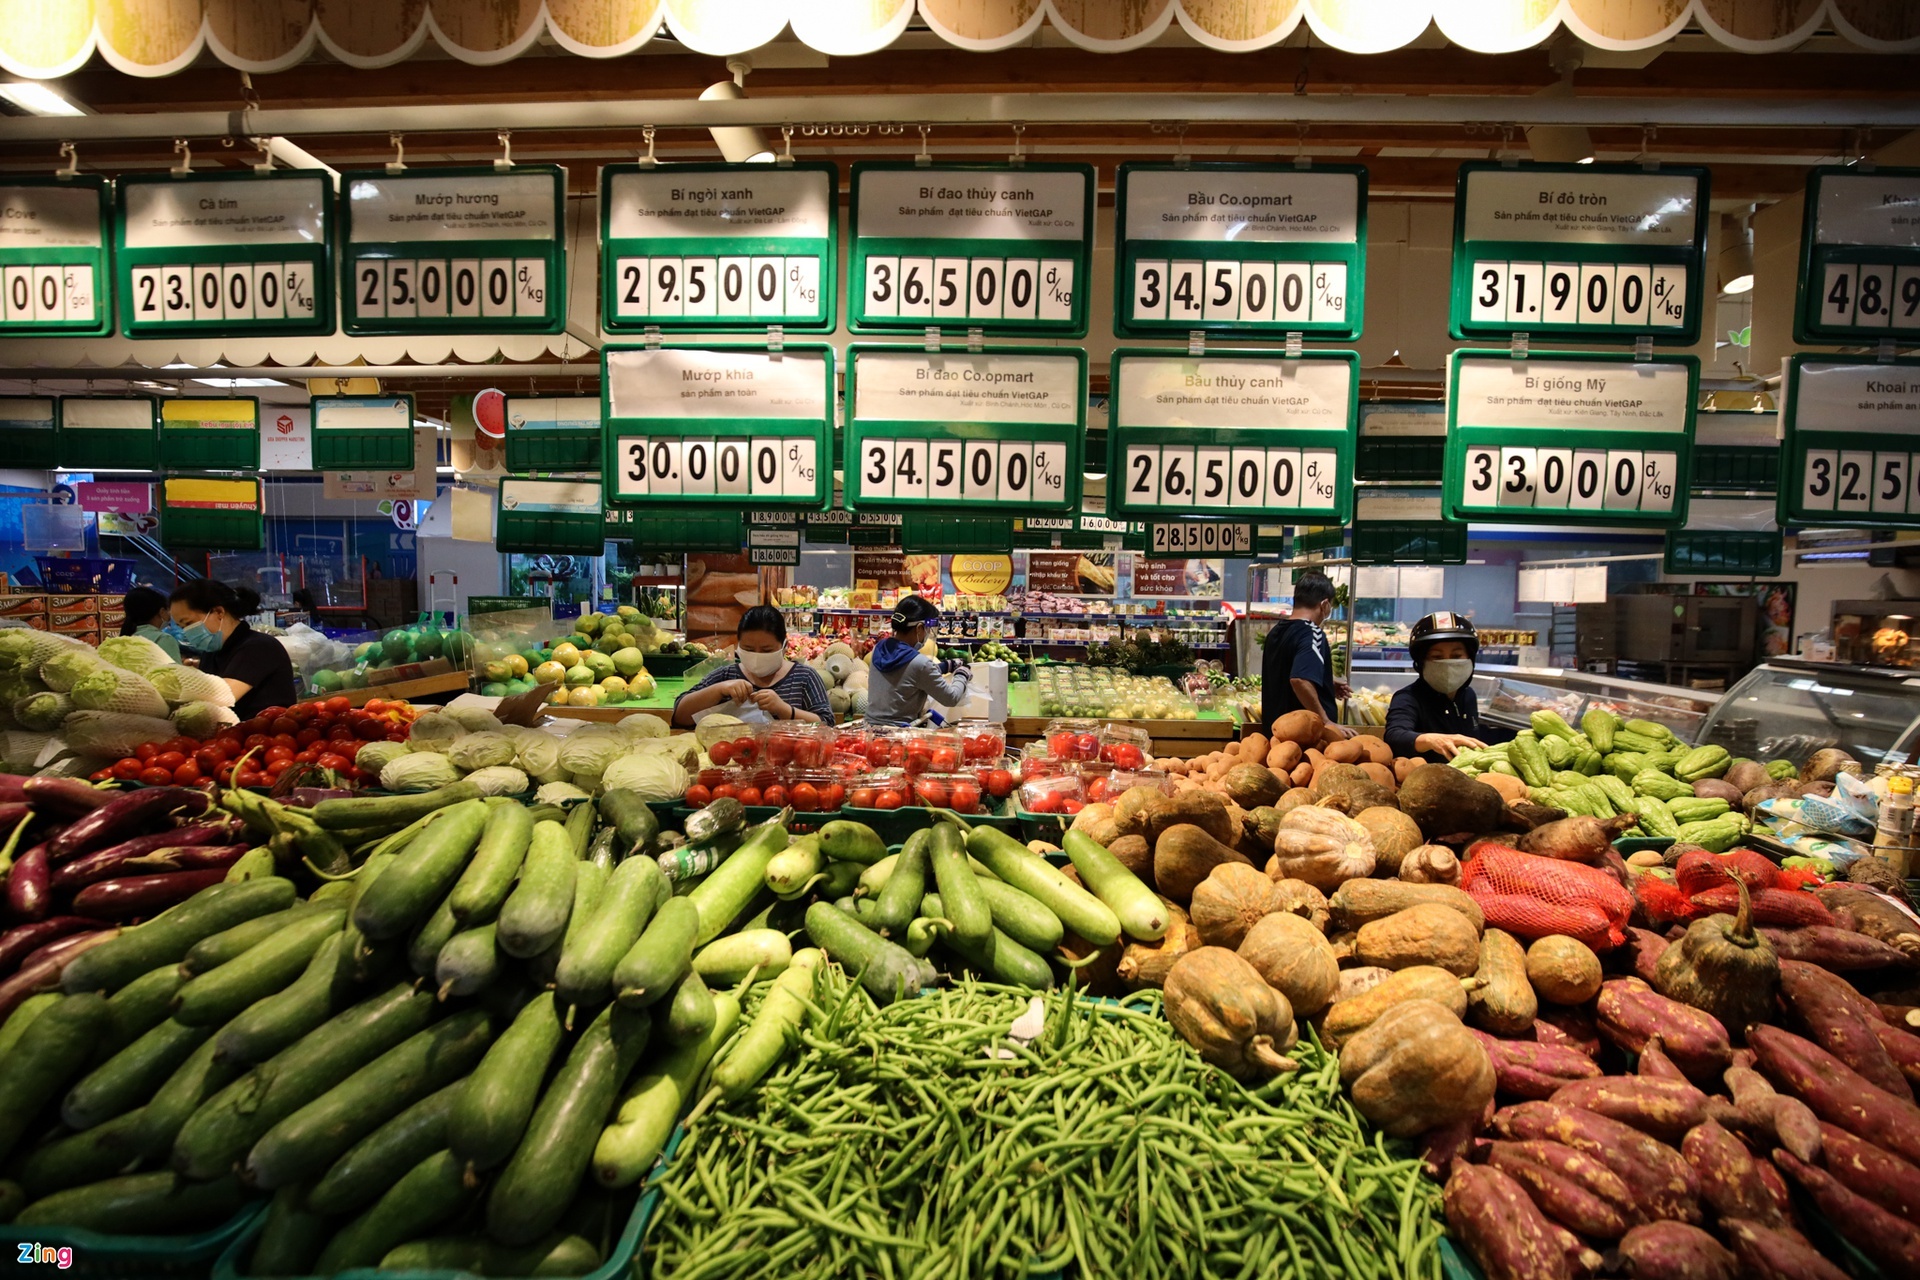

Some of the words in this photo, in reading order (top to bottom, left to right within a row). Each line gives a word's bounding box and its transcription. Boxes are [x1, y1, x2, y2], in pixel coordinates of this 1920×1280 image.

[671, 188, 685, 201] Bí
[688, 188, 717, 204] ngòi
[721, 187, 753, 200] xanh
[919, 187, 934, 199] Bí
[937, 187, 963, 200] đao
[966, 187, 997, 202] thủy
[1000, 189, 1034, 201] canh
[1188, 191, 1215, 205] Bầu
[1219, 193, 1293, 207] Co.opmart
[1538, 191, 1554, 204] Bí
[1557, 191, 1575, 205] đỏ
[1579, 192, 1607, 206] tròn
[748, 207, 785, 216] VietGAP
[1014, 208, 1053, 218] VietGAP
[1278, 214, 1317, 223] VietGAP
[1610, 212, 1649, 224] VietGA
[361, 266, 508, 306] 25.000
[623, 264, 776, 303] 29.500
[872, 264, 1032, 308] 36.500
[1140, 268, 1303, 312] 34.500
[1479, 269, 1643, 314] 31.900
[139, 272, 279, 312] 23.000
[1828, 274, 1920, 317] 48.9
[682, 369, 722, 384] Mướp
[726, 369, 753, 380] khía
[916, 368, 931, 380] Bí
[933, 368, 959, 381] đao
[963, 369, 1034, 384] Co.opmart
[1185, 374, 1212, 387] Bầu
[1215, 374, 1246, 389] thủy
[1249, 375, 1284, 388] canh
[1525, 376, 1540, 389] Bí
[1543, 376, 1582, 393] giống
[1586, 378, 1607, 393] Mỹ
[1866, 381, 1906, 393] Khoai
[1011, 391, 1049, 400] VietGAP
[1271, 396, 1310, 406] VietGAP
[1604, 399, 1643, 408] VietGAP
[1905, 402, 1917, 410] an
[628, 442, 776, 484] 30.000
[867, 447, 1027, 490] 34.500
[1132, 455, 1294, 498] 26.500
[1472, 452, 1635, 498] 33.000
[1810, 458, 1920, 500] 32.5
[1156, 527, 1232, 546] 28.500
[1152, 562, 1166, 570] sinh
